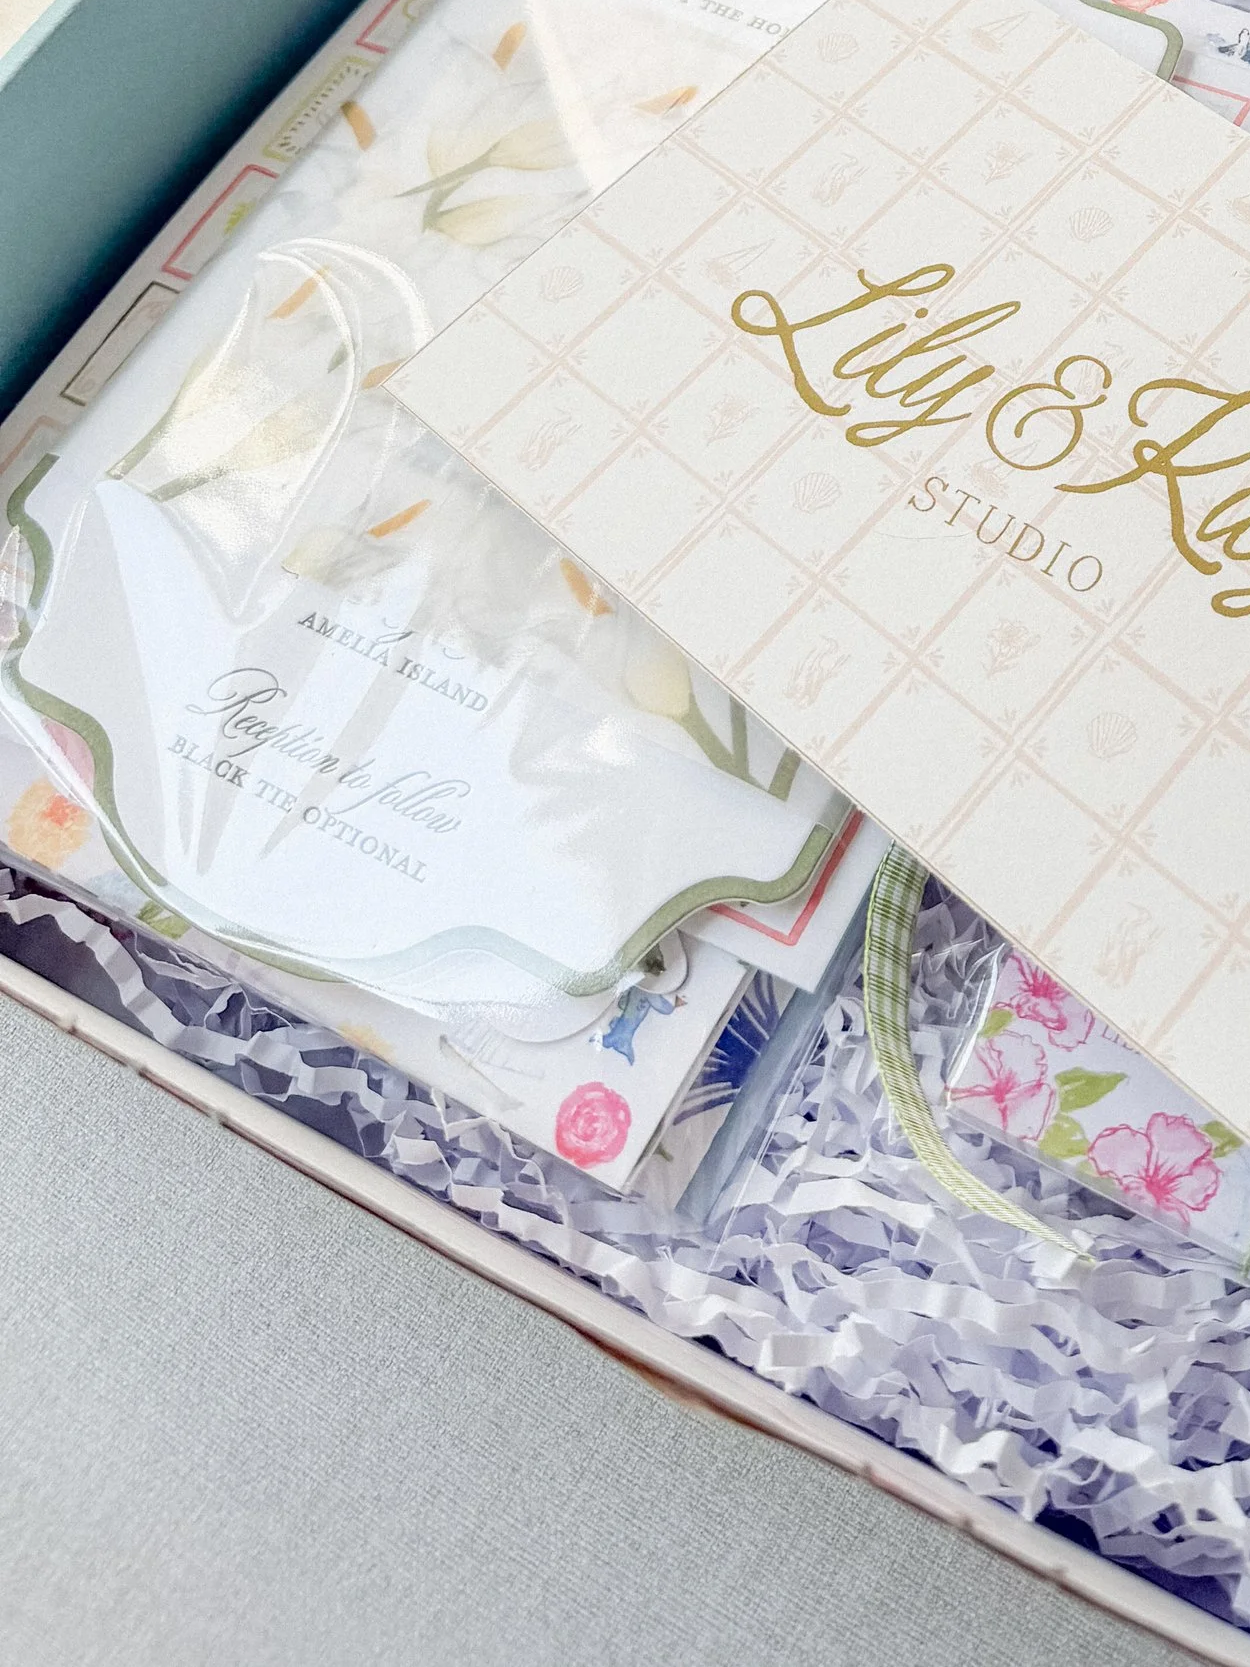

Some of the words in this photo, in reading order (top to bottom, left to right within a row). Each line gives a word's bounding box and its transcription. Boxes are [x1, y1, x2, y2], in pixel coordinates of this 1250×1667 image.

[731, 263, 1022, 447] Lily
[985, 354, 1113, 472] &
[907, 475, 1104, 593] STUDIO
[298, 610, 390, 667] AMELIA
[396, 656, 491, 713] ISLAND
[185, 667, 341, 776] Reception
[338, 757, 376, 790] to
[168, 735, 256, 790] BLACK
[257, 778, 299, 814] TIE
[302, 805, 429, 884] OPTIONAL
[324, 770, 472, 835] follow
